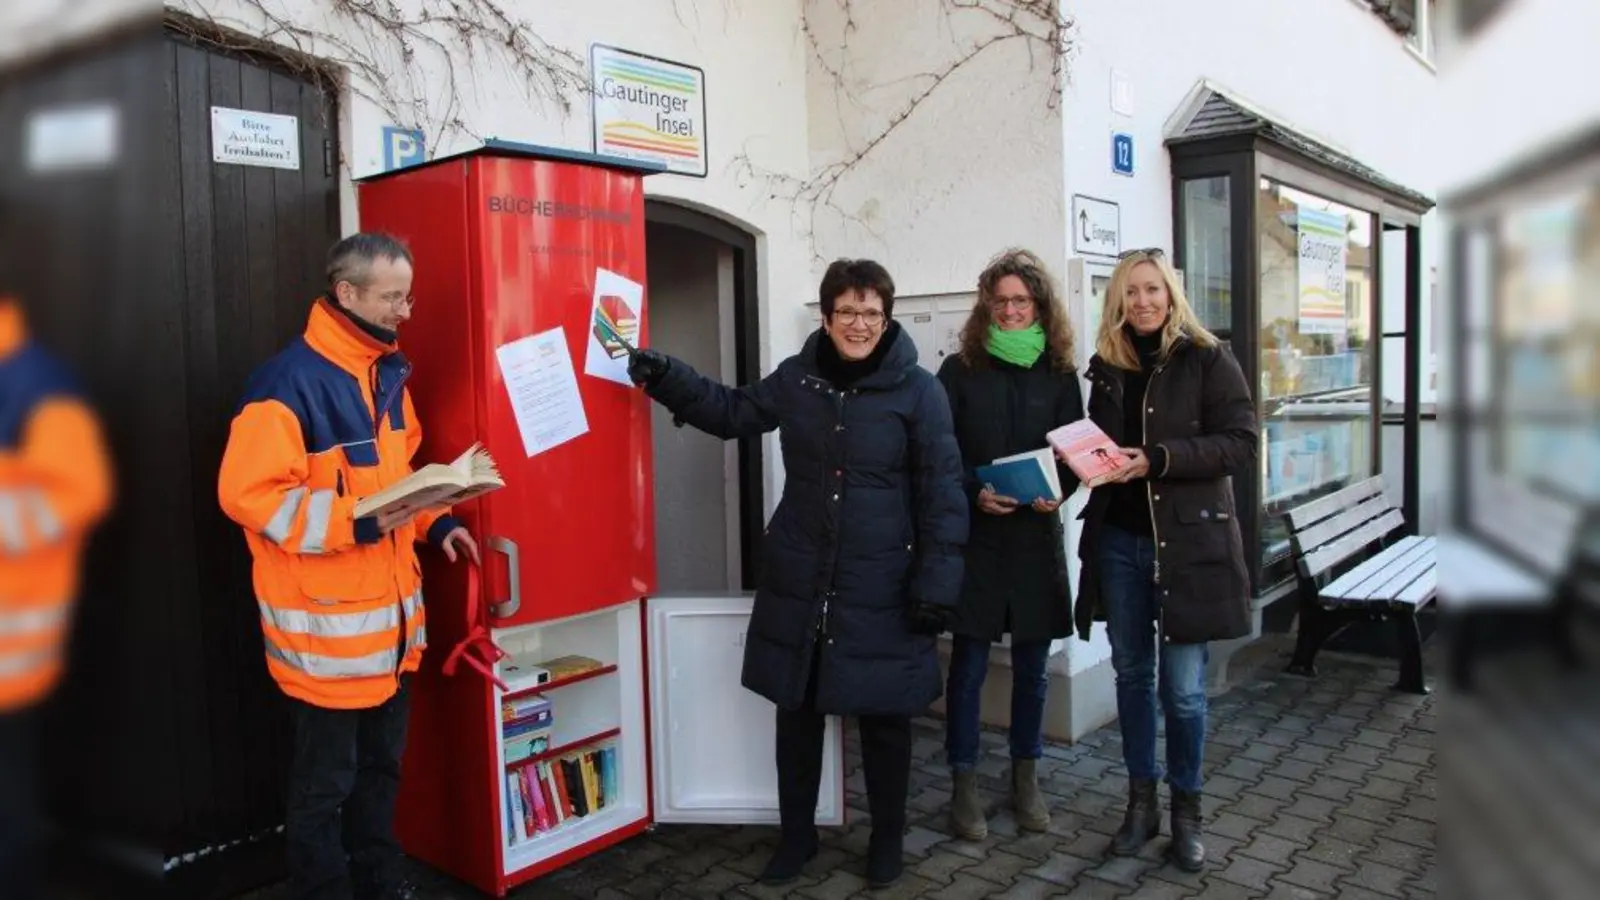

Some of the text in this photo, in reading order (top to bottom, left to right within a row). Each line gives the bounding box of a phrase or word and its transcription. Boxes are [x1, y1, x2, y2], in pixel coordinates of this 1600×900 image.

[602, 78, 689, 114] Gautinger
[241, 119, 271, 132] Bitte
[655, 113, 693, 137] Insel
[228, 131, 284, 146] Ausfahrt
[392, 132, 416, 169] P
[1117, 141, 1129, 166] 12
[488, 194, 631, 226] BÜCHERSCH
[1092, 224, 1116, 247] Eingang
